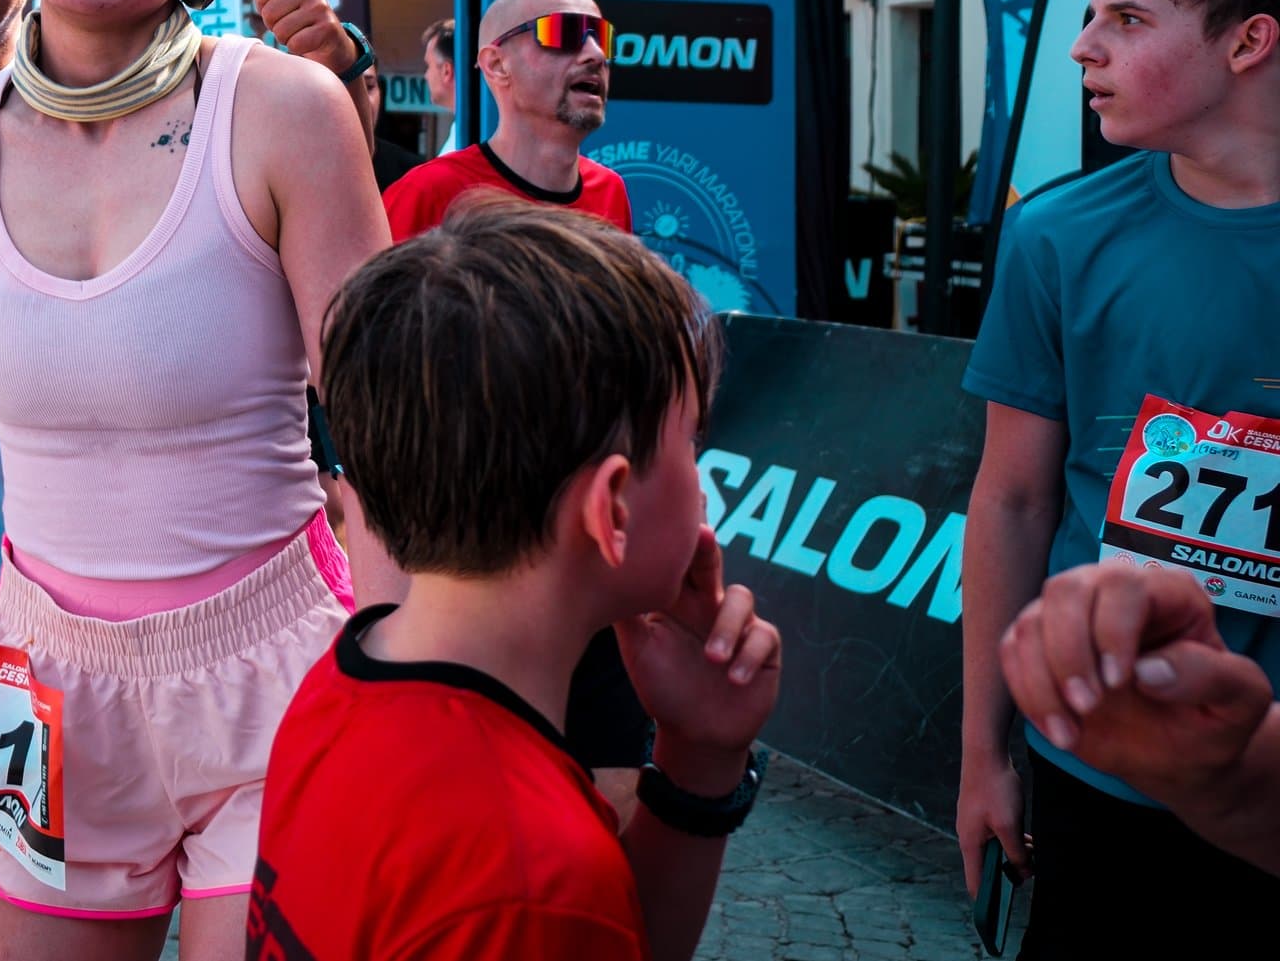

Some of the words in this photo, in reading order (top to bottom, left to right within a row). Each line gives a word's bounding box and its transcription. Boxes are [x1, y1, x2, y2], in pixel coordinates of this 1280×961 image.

[614, 33, 758, 71] OMON
[655, 143, 700, 175] YARI
[693, 166, 759, 280] MARATONU
[696, 448, 967, 625] SALOM
[1234, 590, 1277, 606] GARMIN
